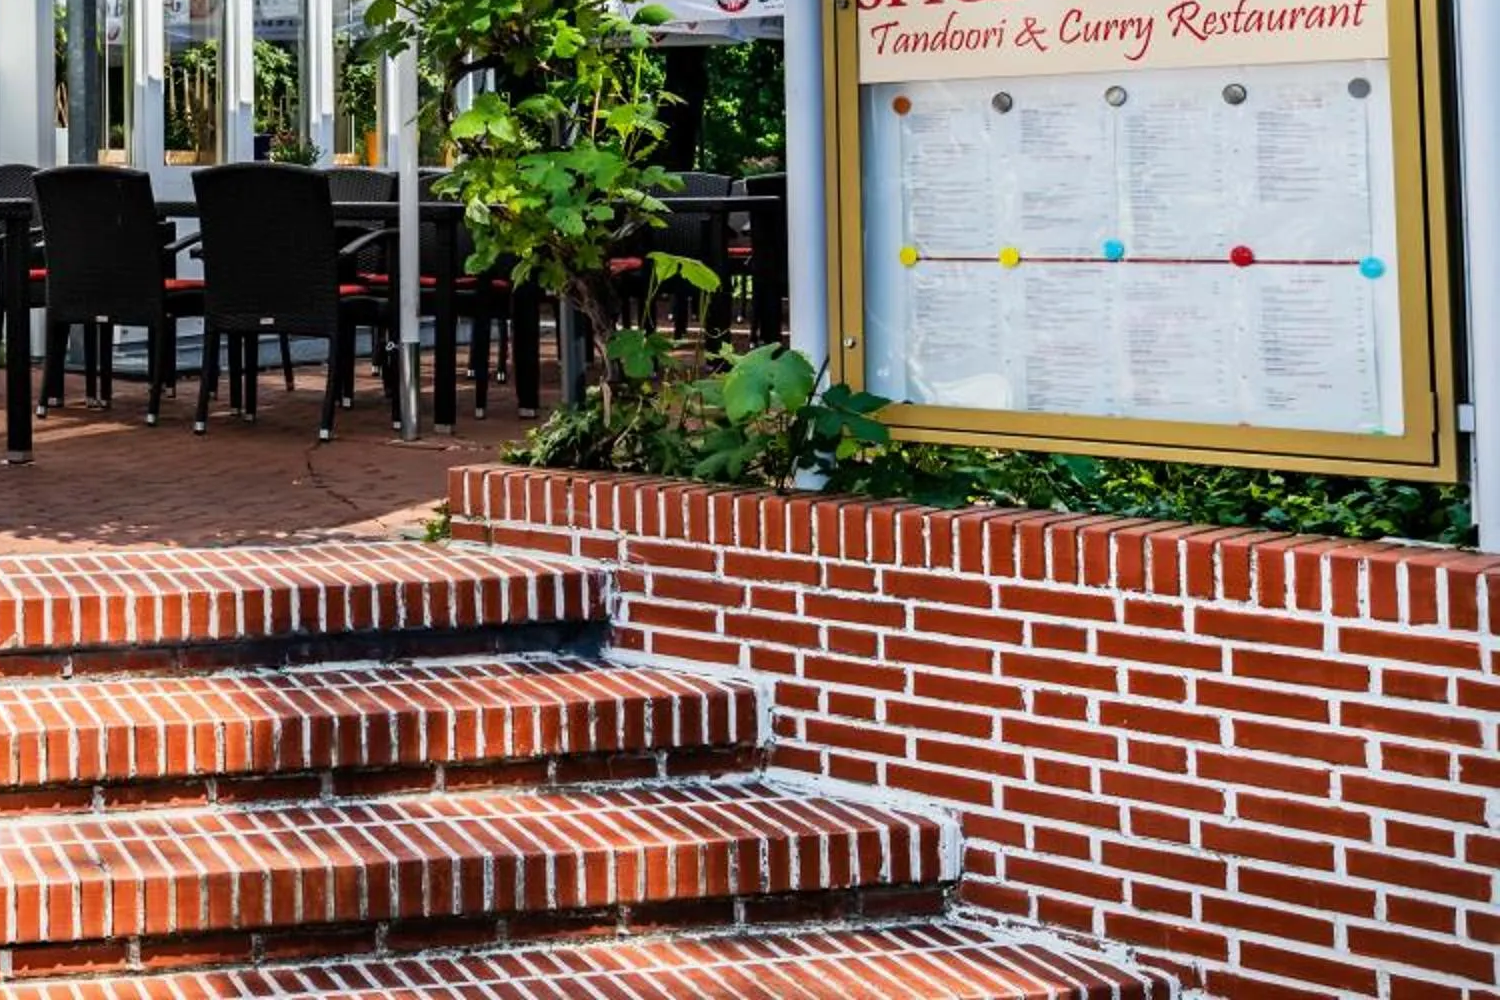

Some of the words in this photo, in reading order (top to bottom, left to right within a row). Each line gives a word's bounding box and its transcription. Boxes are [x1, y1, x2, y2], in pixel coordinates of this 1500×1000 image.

[871, 11, 1007, 55] Tandoori
[1014, 16, 1050, 52] &
[1058, 8, 1154, 61] Curry
